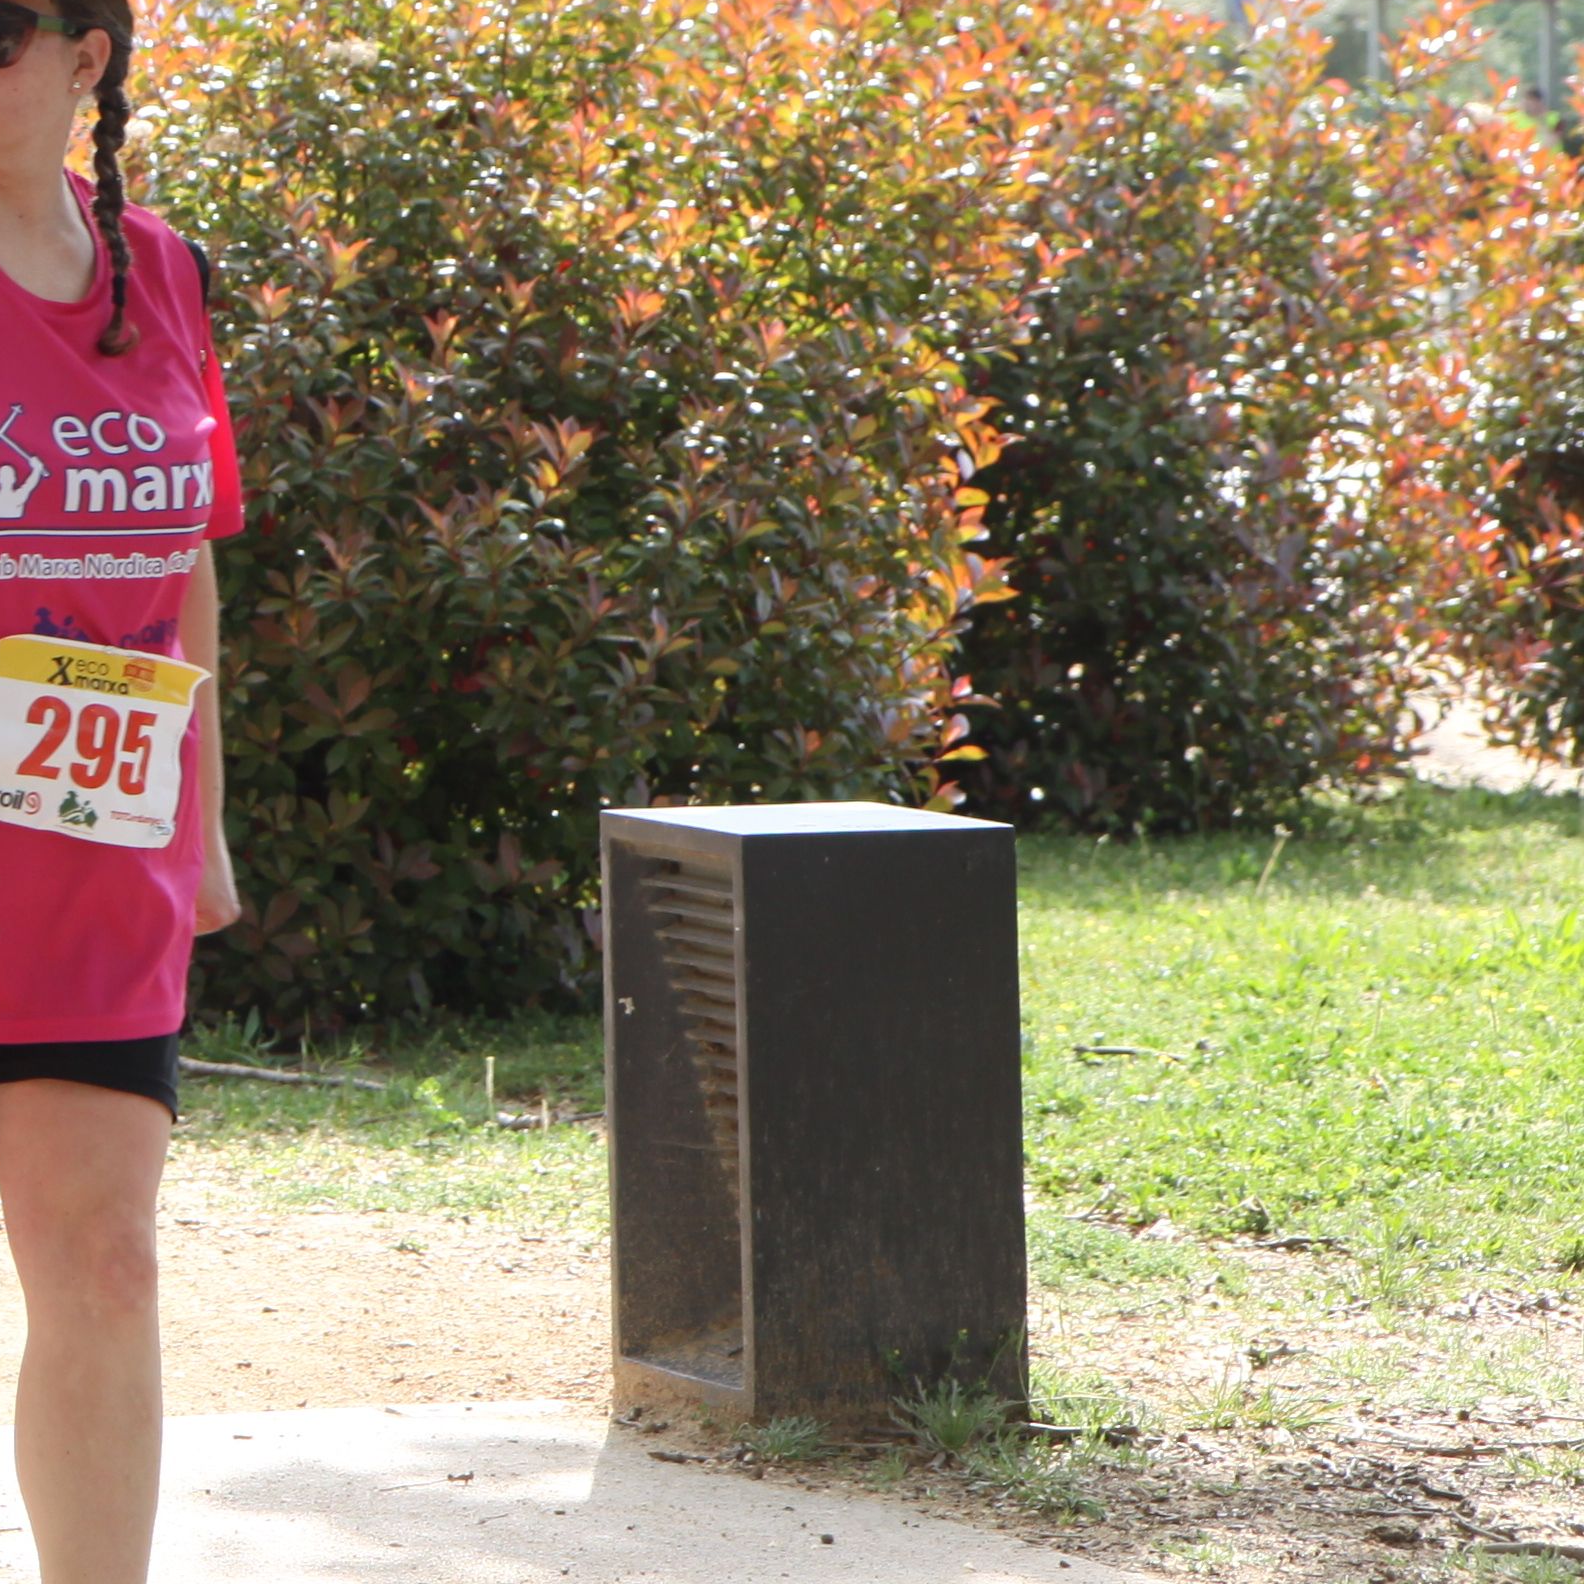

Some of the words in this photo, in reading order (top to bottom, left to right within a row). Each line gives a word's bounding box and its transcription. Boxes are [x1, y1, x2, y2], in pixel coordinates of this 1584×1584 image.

[52, 411, 166, 457] eco
[64, 460, 214, 513] marx
[17, 553, 83, 579] Marxa
[84, 552, 165, 579] Nòrdica
[46, 655, 74, 686] X
[75, 658, 110, 677] eco
[74, 675, 130, 695] marxa
[16, 695, 159, 795] 295
